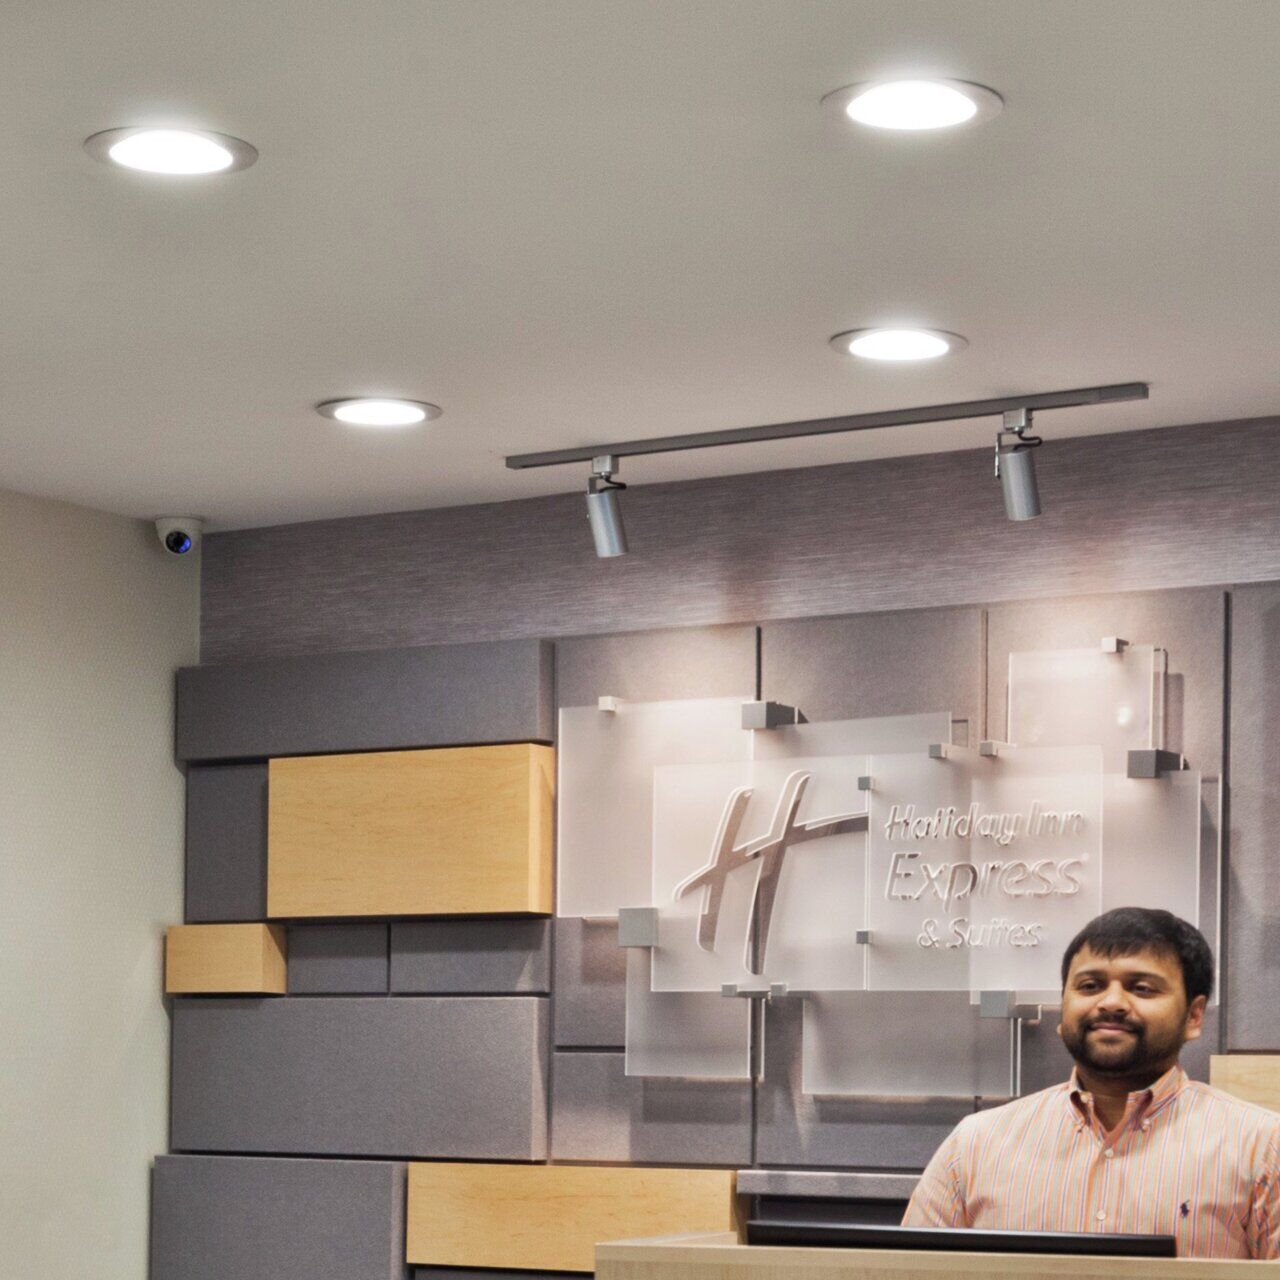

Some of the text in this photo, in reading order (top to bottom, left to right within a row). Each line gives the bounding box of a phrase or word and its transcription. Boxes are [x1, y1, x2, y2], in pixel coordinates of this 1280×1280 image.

[884, 801, 1084, 846] Holiday Inn
[884, 852, 1084, 913] Express
[917, 918, 1043, 949] & Suites
